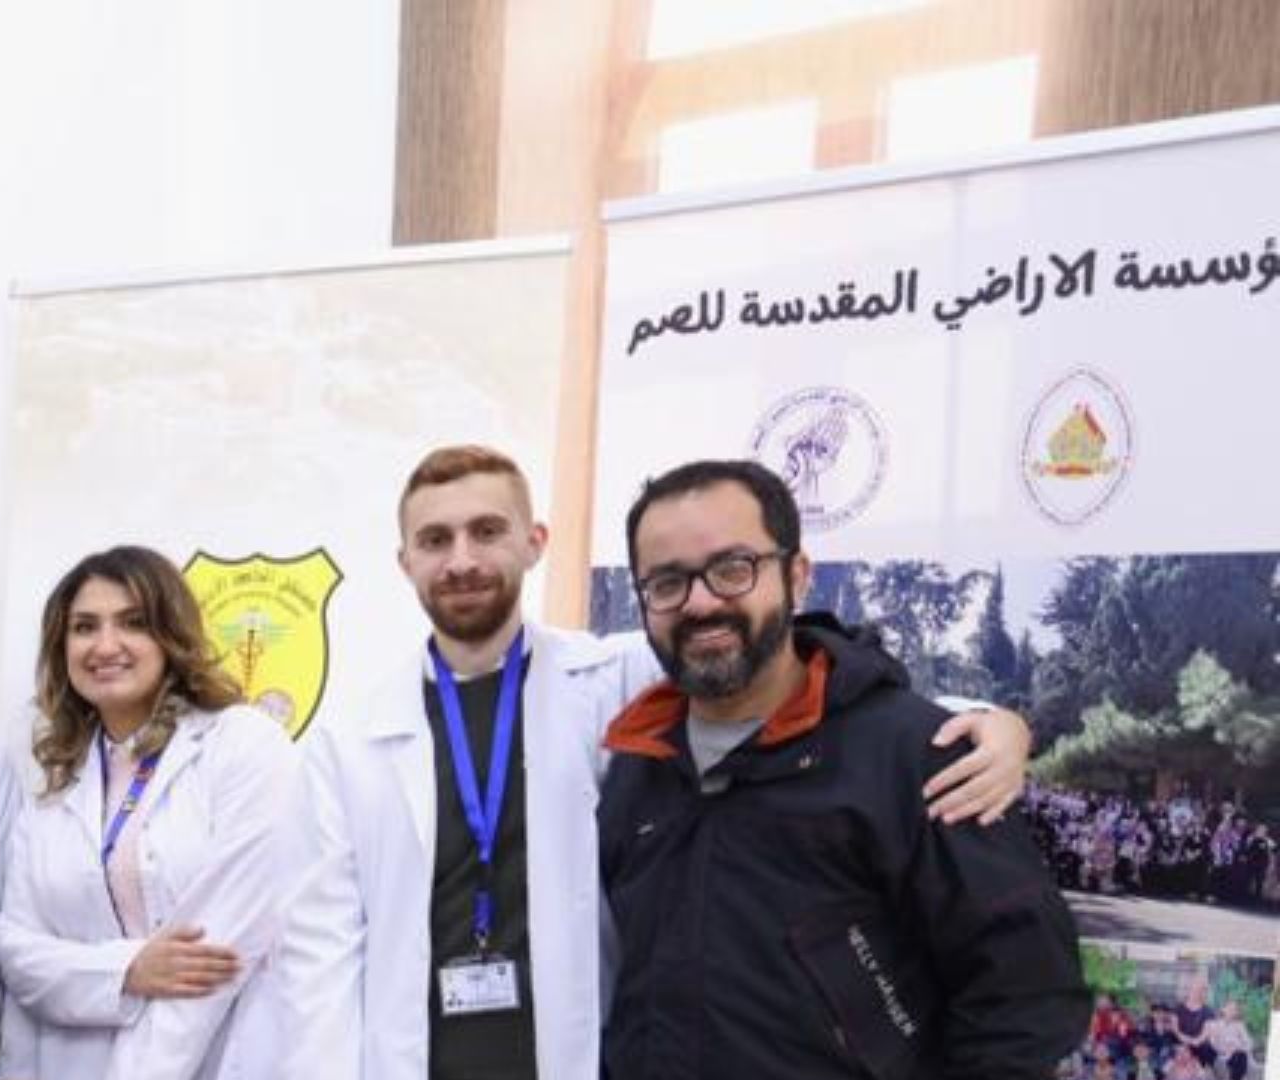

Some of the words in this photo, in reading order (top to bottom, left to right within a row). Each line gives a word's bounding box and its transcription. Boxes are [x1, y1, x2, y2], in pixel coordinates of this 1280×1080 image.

[740, 267, 918, 327] المقدسة
[933, 248, 1097, 331] الاراضي
[1114, 237, 1280, 295] ؤسسة
[627, 288, 726, 355] للصم
